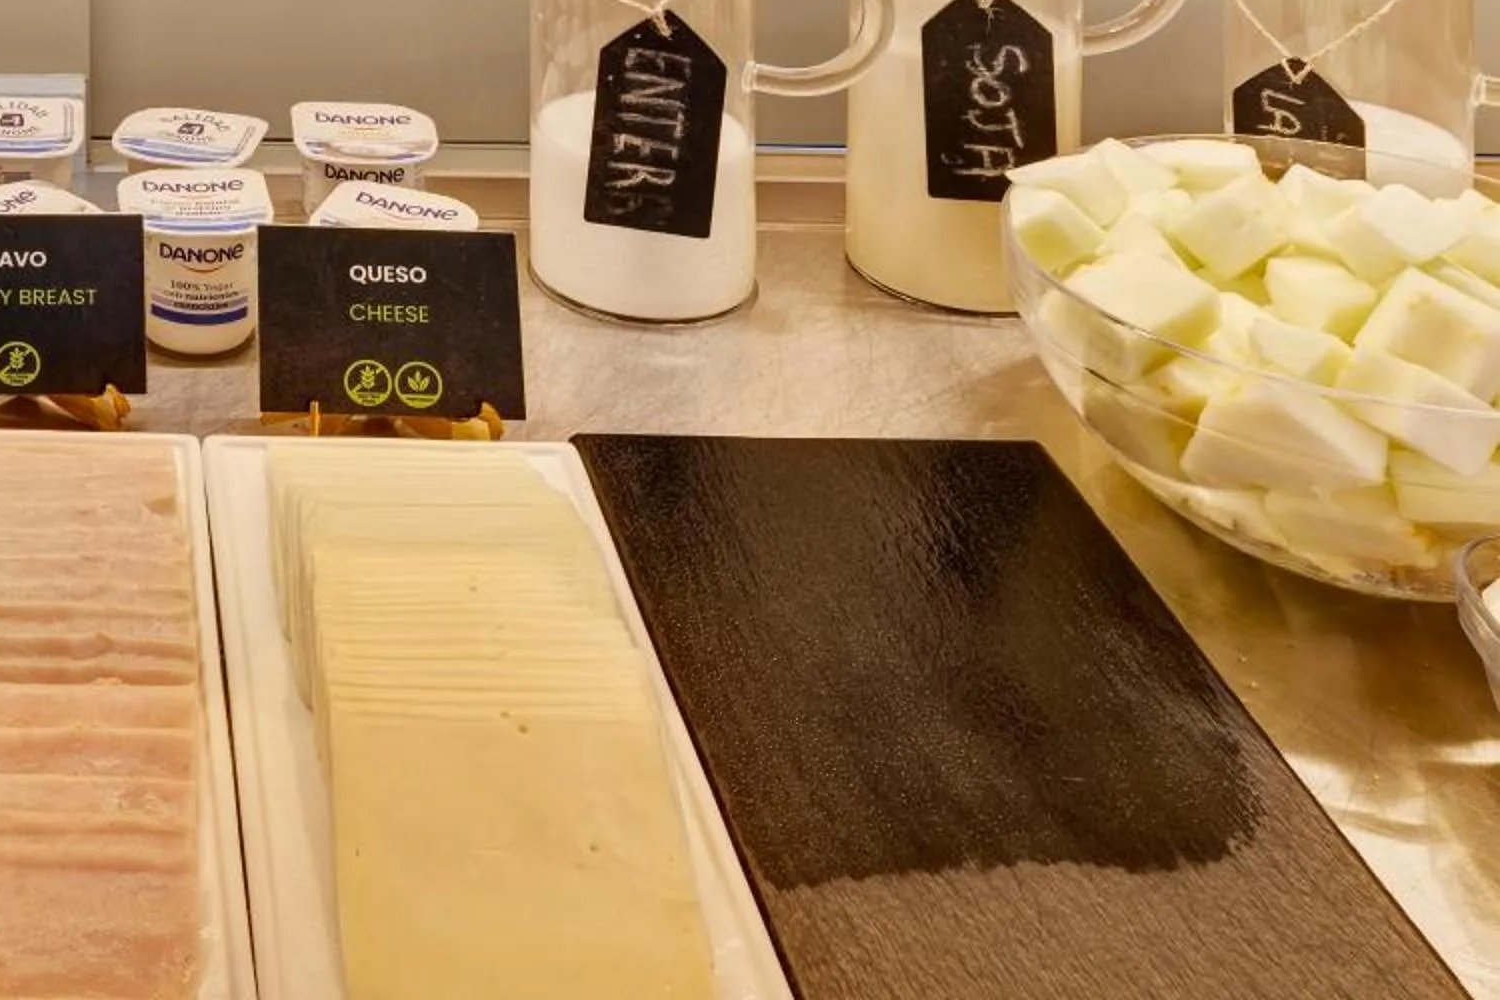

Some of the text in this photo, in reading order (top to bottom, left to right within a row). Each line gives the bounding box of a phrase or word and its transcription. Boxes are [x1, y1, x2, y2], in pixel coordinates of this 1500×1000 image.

[349, 263, 428, 285] QUESO
[18, 288, 97, 306] BREAST
[349, 302, 430, 323] CHEESE
